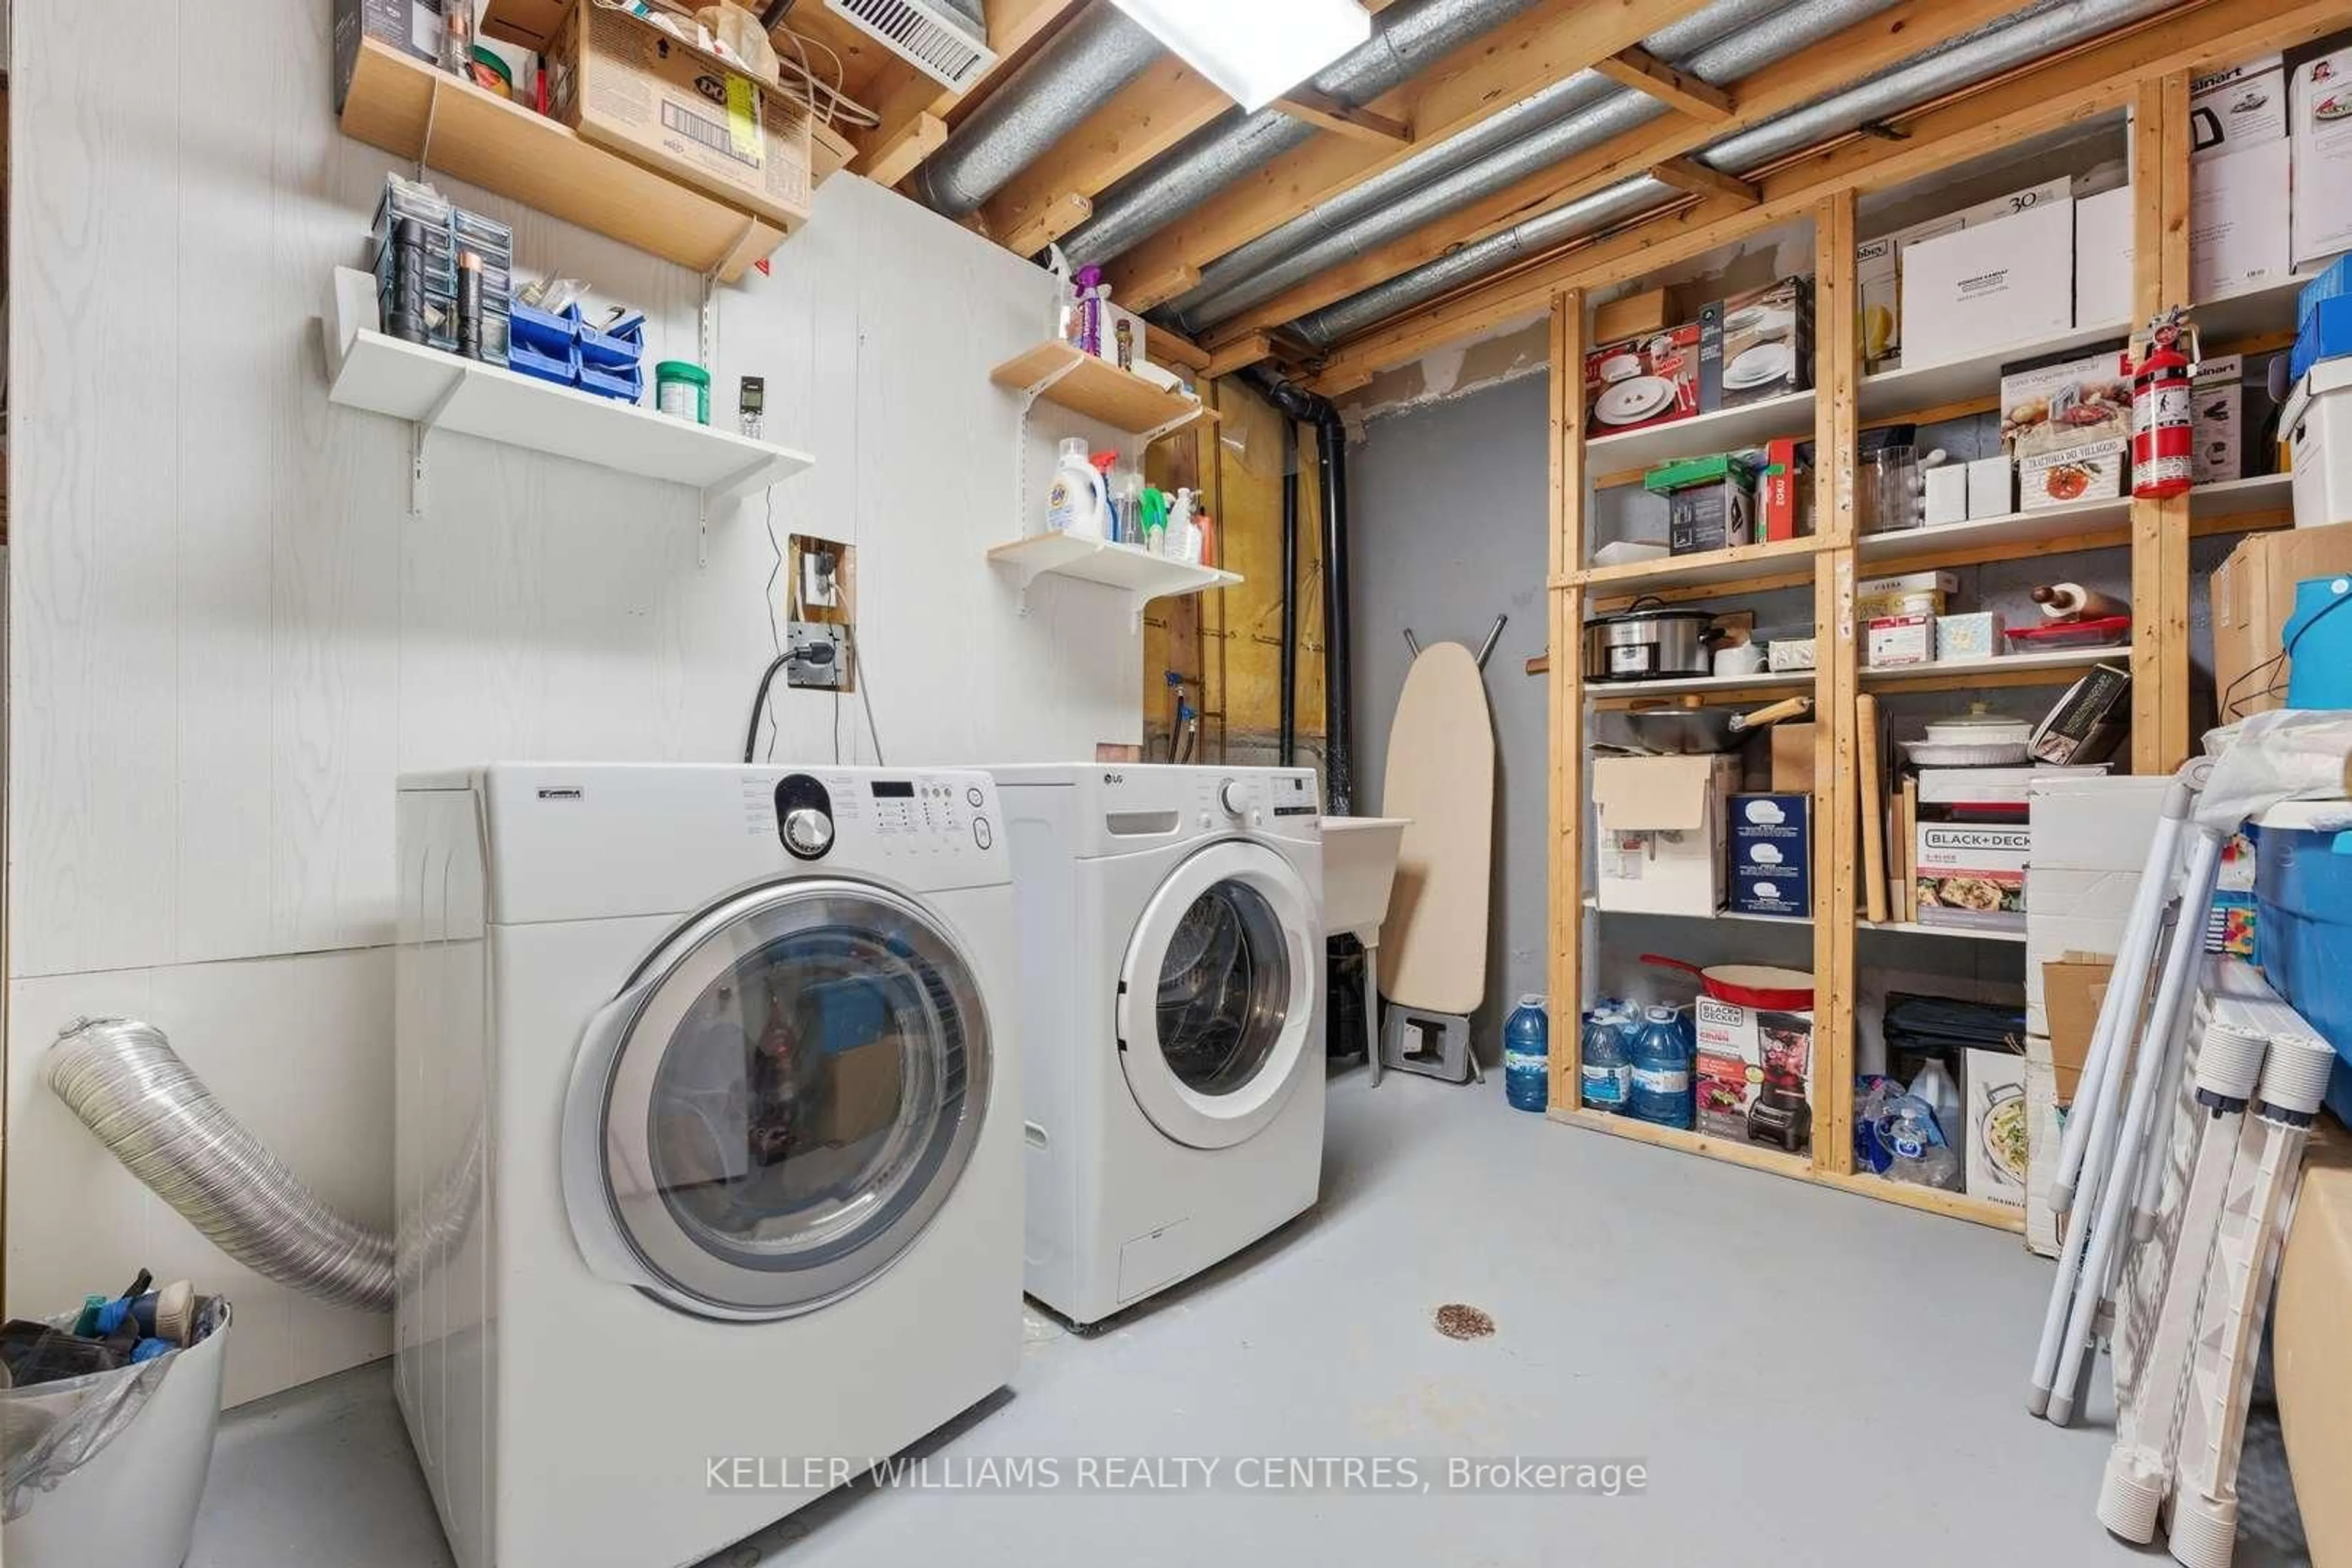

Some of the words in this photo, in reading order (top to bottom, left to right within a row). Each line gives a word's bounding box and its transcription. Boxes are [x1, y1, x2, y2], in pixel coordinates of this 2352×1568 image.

[2190, 67, 2242, 92] sinart
[2009, 192, 2037, 214] 30
[2196, 364, 2235, 377] sinart
[1931, 833, 2031, 846] BLACK+DECK
